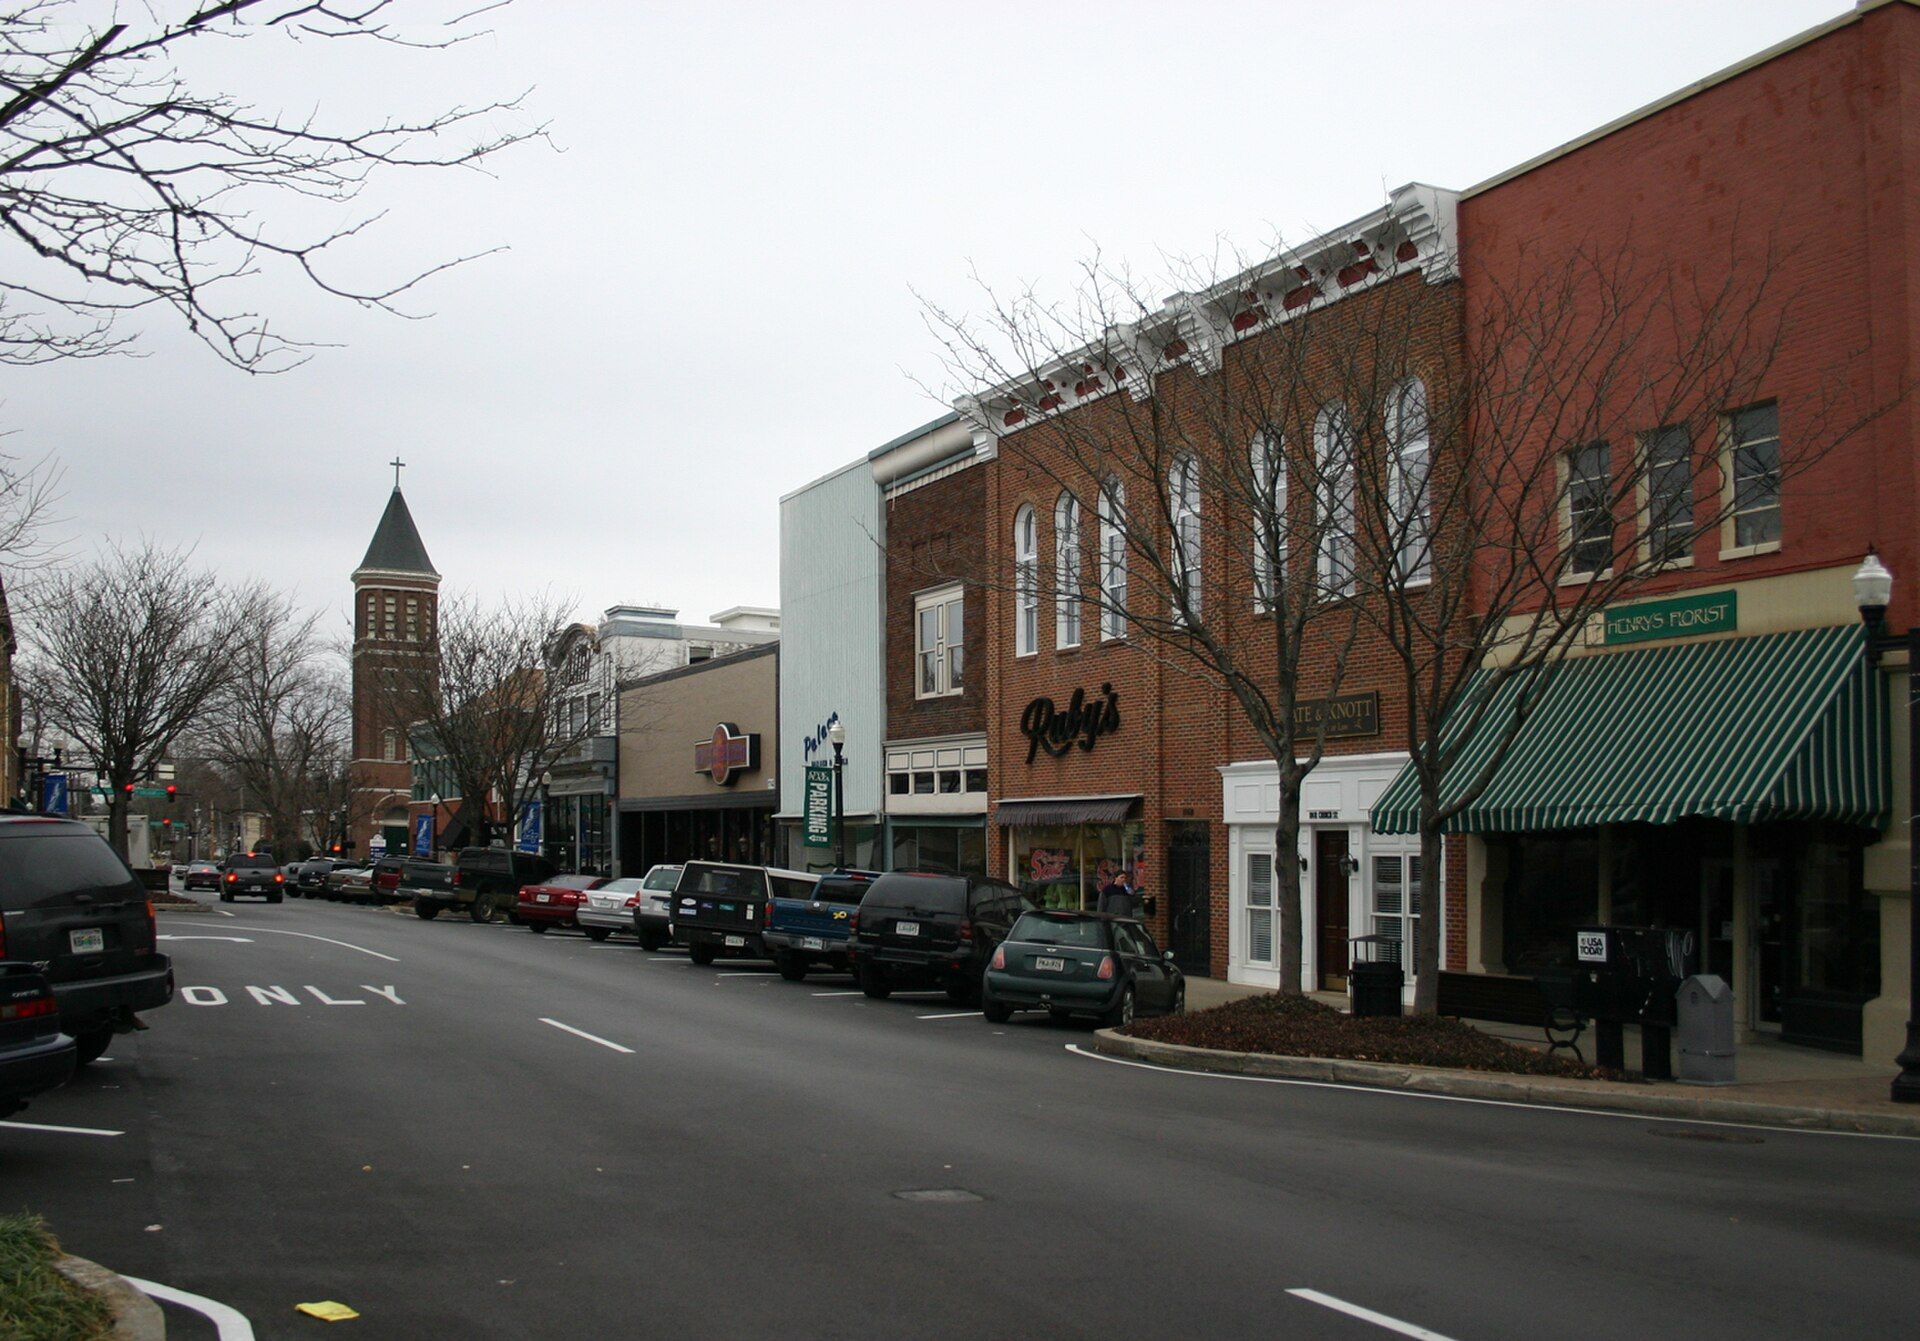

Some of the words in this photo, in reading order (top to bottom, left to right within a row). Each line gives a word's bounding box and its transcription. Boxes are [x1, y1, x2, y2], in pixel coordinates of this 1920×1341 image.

[1670, 604, 1729, 628] FLORIST
[1328, 699, 1373, 721] KNOTT
[1020, 682, 1120, 765] Ruby's
[808, 782, 829, 833] PARKING
[1579, 945, 1605, 956] TODAY
[1587, 937, 1603, 947] USA
[180, 985, 407, 1006] ONLY
